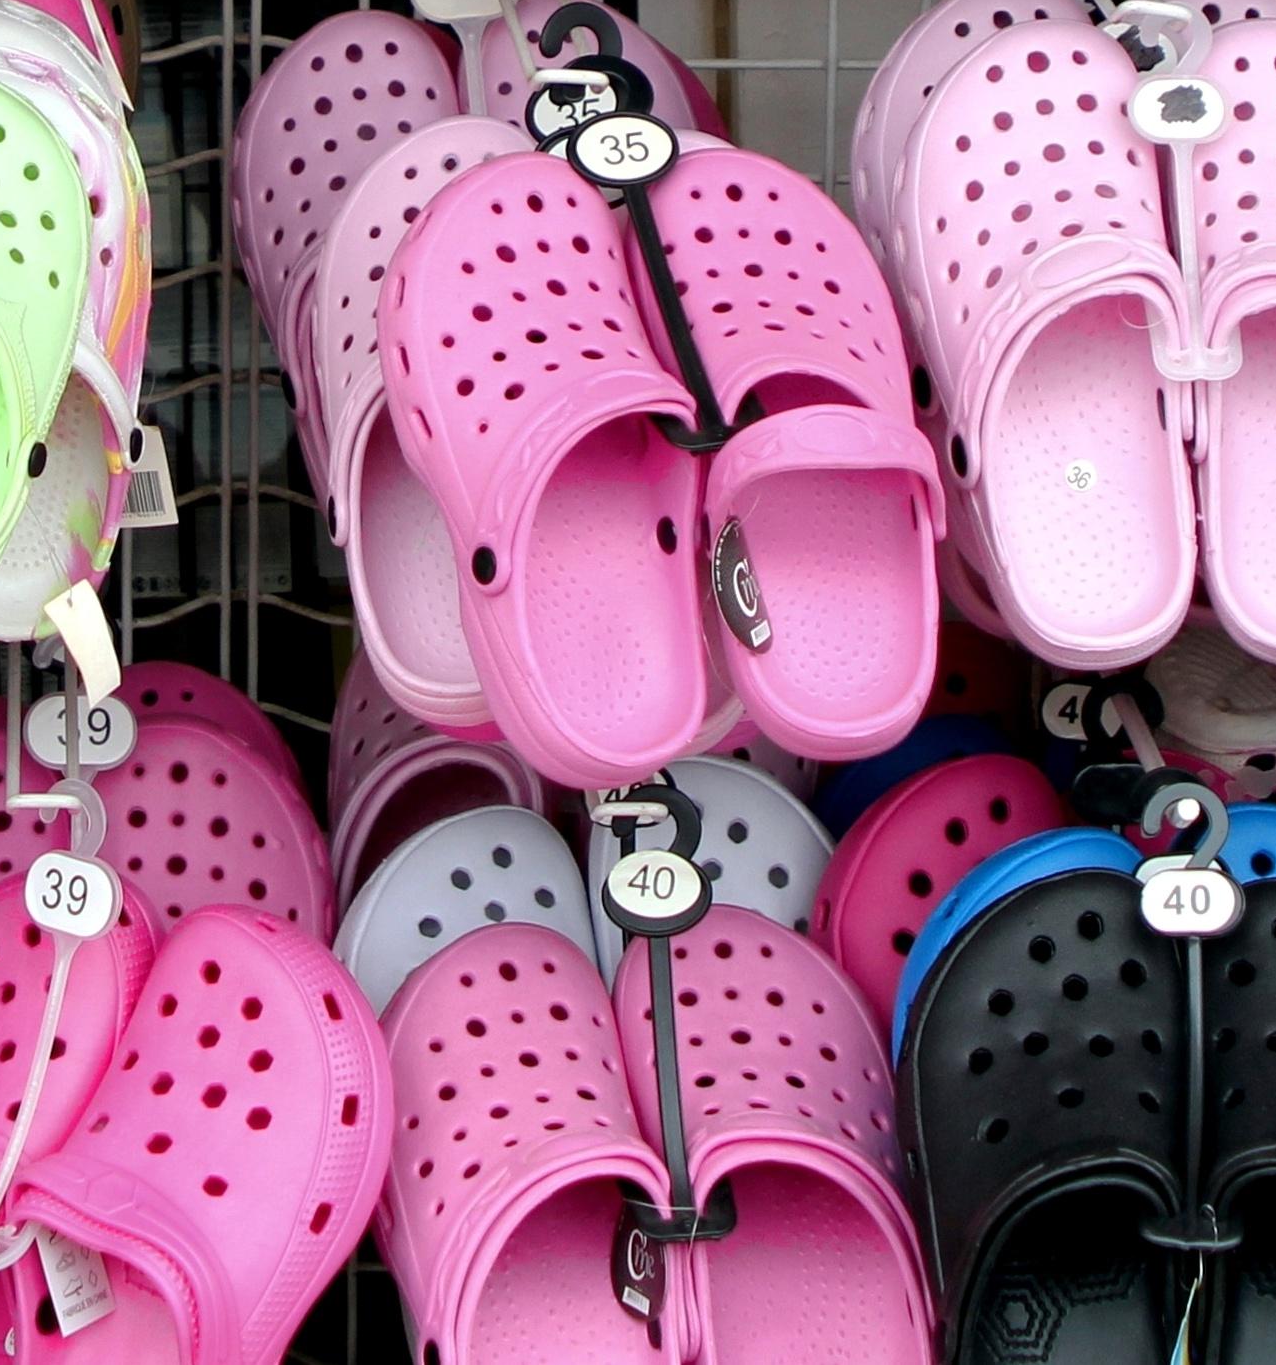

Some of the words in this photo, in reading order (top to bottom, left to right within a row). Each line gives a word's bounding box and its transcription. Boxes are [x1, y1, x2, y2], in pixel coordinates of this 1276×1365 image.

[600, 131, 649, 166] 35
[1066, 465, 1092, 490] 36
[42, 868, 89, 916] 39
[627, 864, 675, 900] 40
[1163, 884, 1211, 915] 40
